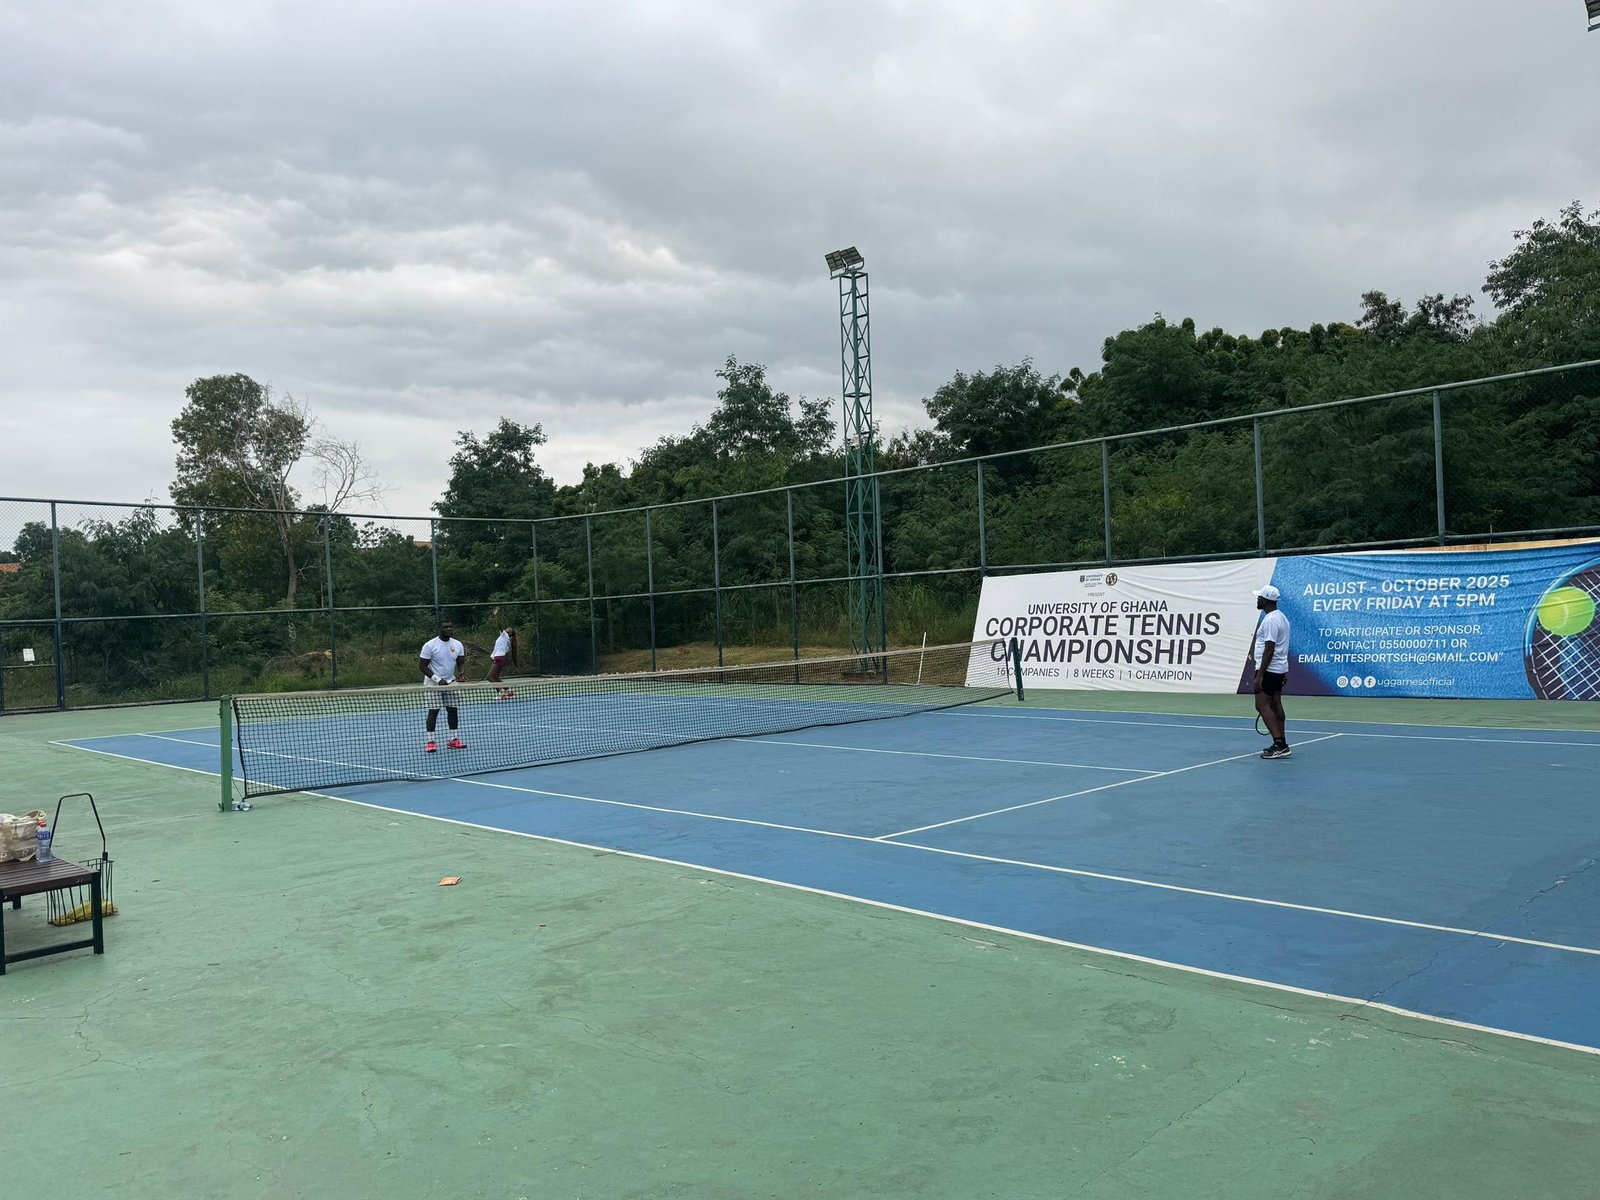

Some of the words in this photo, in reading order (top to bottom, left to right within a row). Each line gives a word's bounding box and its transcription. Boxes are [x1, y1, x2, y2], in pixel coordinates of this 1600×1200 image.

[1303, 581, 1367, 596] AUGUST
[1381, 578, 1461, 593] OCTOBER
[1465, 574, 1510, 589] 2025
[1028, 602, 1097, 614] UNIVERSITY
[1100, 602, 1117, 613] OF
[1120, 600, 1168, 612] GHANA
[1313, 598, 1362, 612] EVERY
[1366, 595, 1423, 610] FRIDAY
[1428, 594, 1451, 608] AT
[1455, 593, 1495, 607] 5PM
[985, 614, 1119, 637] CORPORATE
[1126, 612, 1221, 636] TENNIS
[1318, 628, 1332, 637] TO
[1334, 627, 1402, 637] PARTICIPATE
[1405, 625, 1421, 635] OR
[1423, 625, 1483, 636] SPONSOR,
[1327, 640, 1377, 650] CONTACT
[1379, 639, 1447, 649] 0550000711
[1451, 638, 1468, 648] OR
[1298, 653, 1330, 663] EMAIL
[996, 668, 1006, 676] 16
[1008, 667, 1060, 678] CMPANIES
[1073, 668, 1080, 678] 8
[1081, 669, 1115, 679] WEEKS
[1128, 670, 1133, 680] 1
[1135, 670, 1193, 681] CHAMPION
[1377, 677, 1455, 687] uggamesofficial
